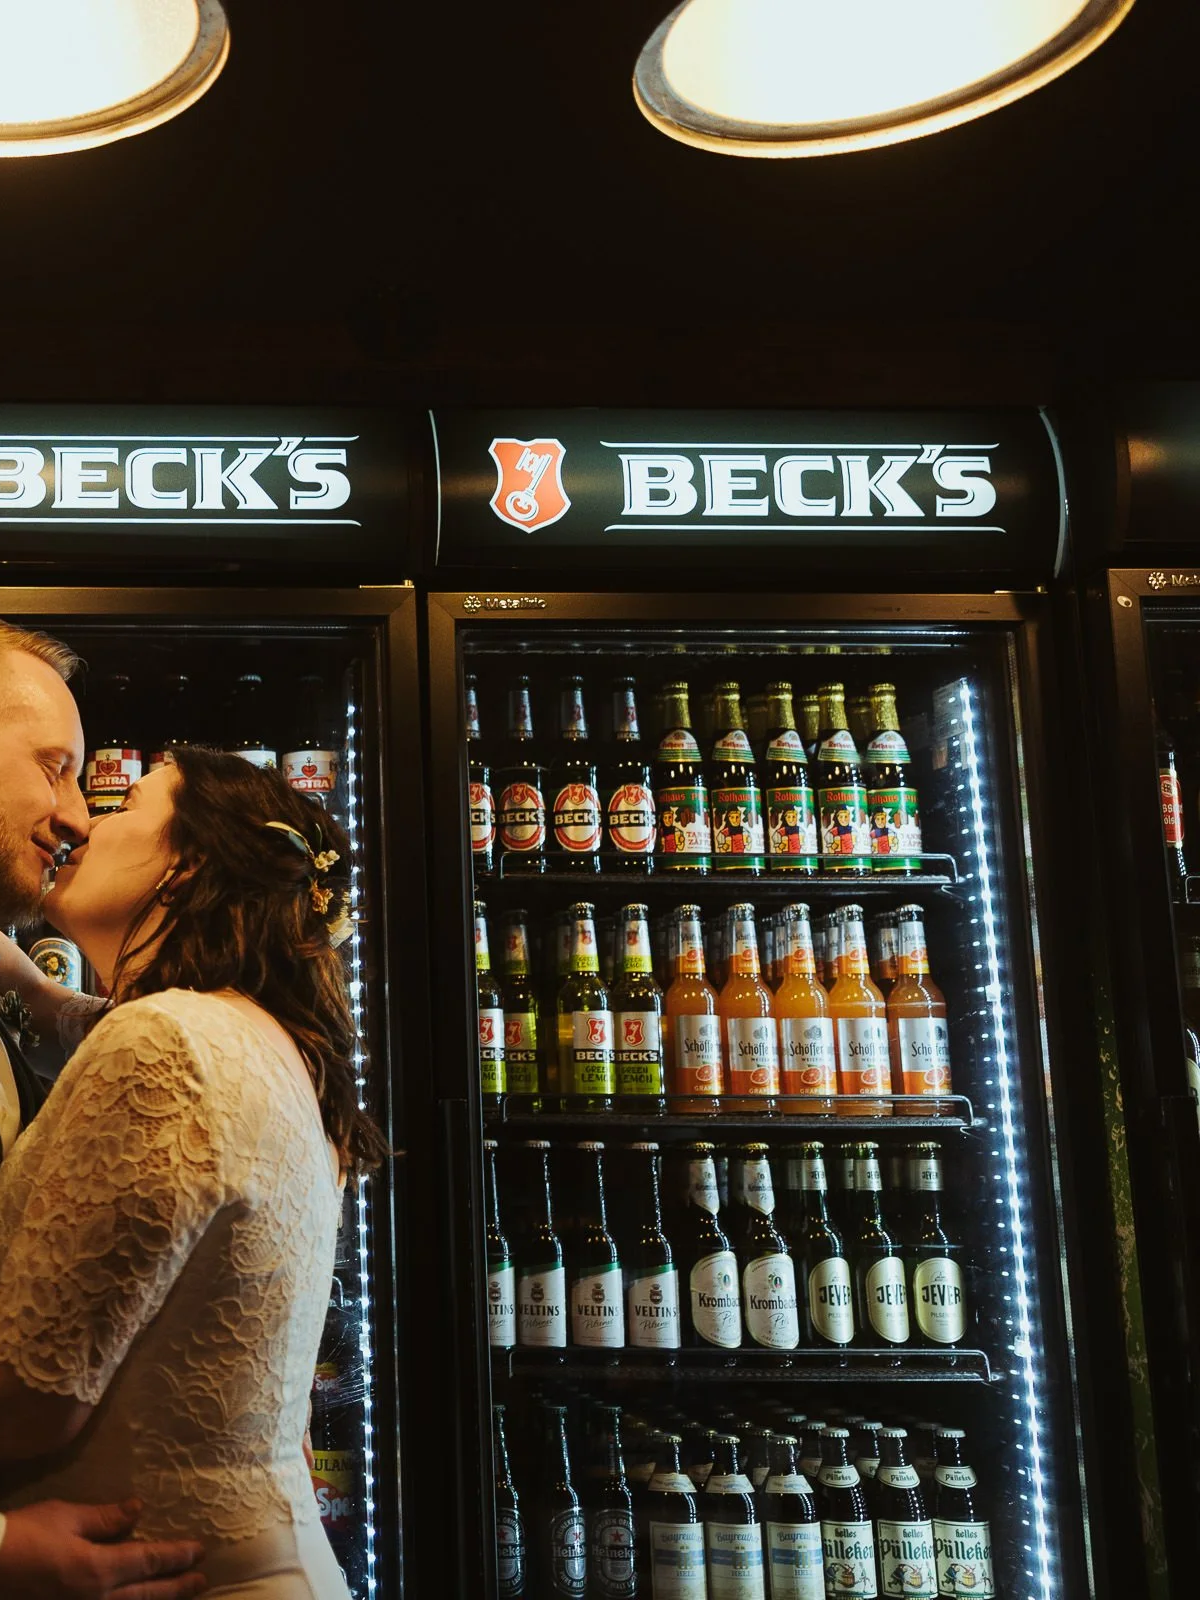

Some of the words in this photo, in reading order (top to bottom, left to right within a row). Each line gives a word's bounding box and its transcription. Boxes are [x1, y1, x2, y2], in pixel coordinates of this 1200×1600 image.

[618, 445, 997, 518] BECK'S
[91, 775, 129, 786] ASTRA
[291, 778, 331, 790] ASTRA
[921, 1284, 961, 1306] JEVER
[489, 1303, 514, 1315] LTINS
[518, 1303, 560, 1316] VELTINS
[577, 1303, 620, 1317] VELTINS
[634, 1304, 677, 1317] VELTINS
